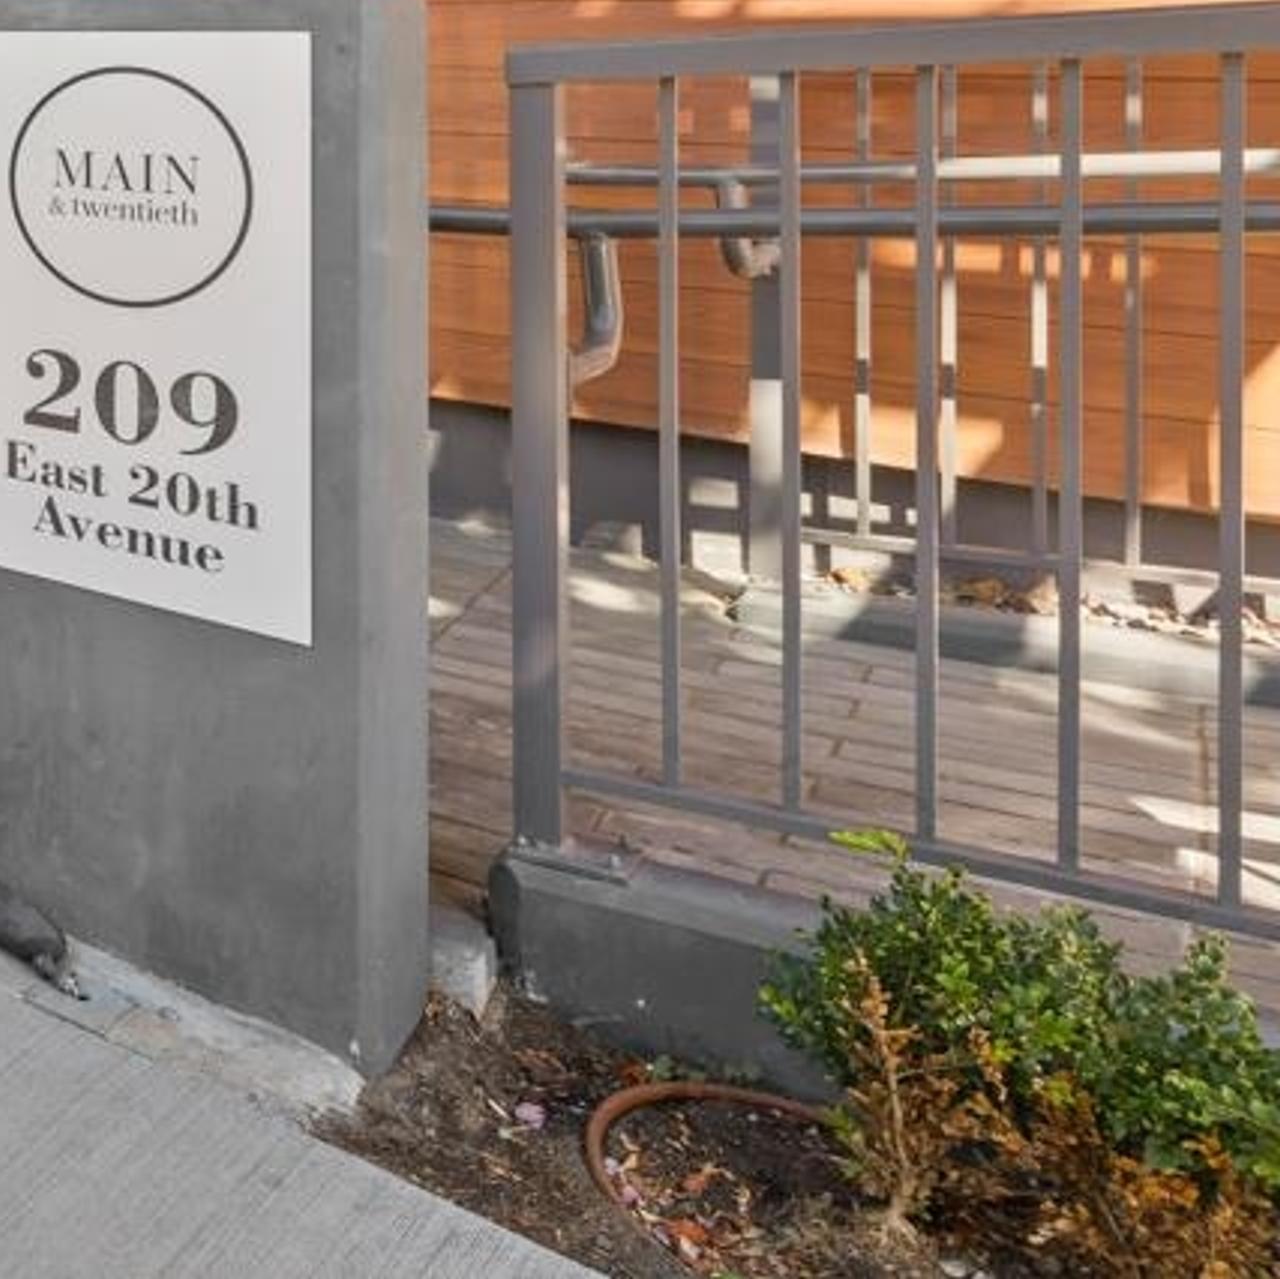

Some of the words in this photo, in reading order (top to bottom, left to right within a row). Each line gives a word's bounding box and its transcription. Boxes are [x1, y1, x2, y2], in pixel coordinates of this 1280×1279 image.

[47, 196, 69, 218] &
[71, 197, 199, 227] twentieth
[53, 148, 200, 195] MAIN
[23, 348, 239, 456] 209
[5, 439, 109, 498] East
[127, 464, 261, 530] 20th
[34, 494, 226, 574] Avenue
